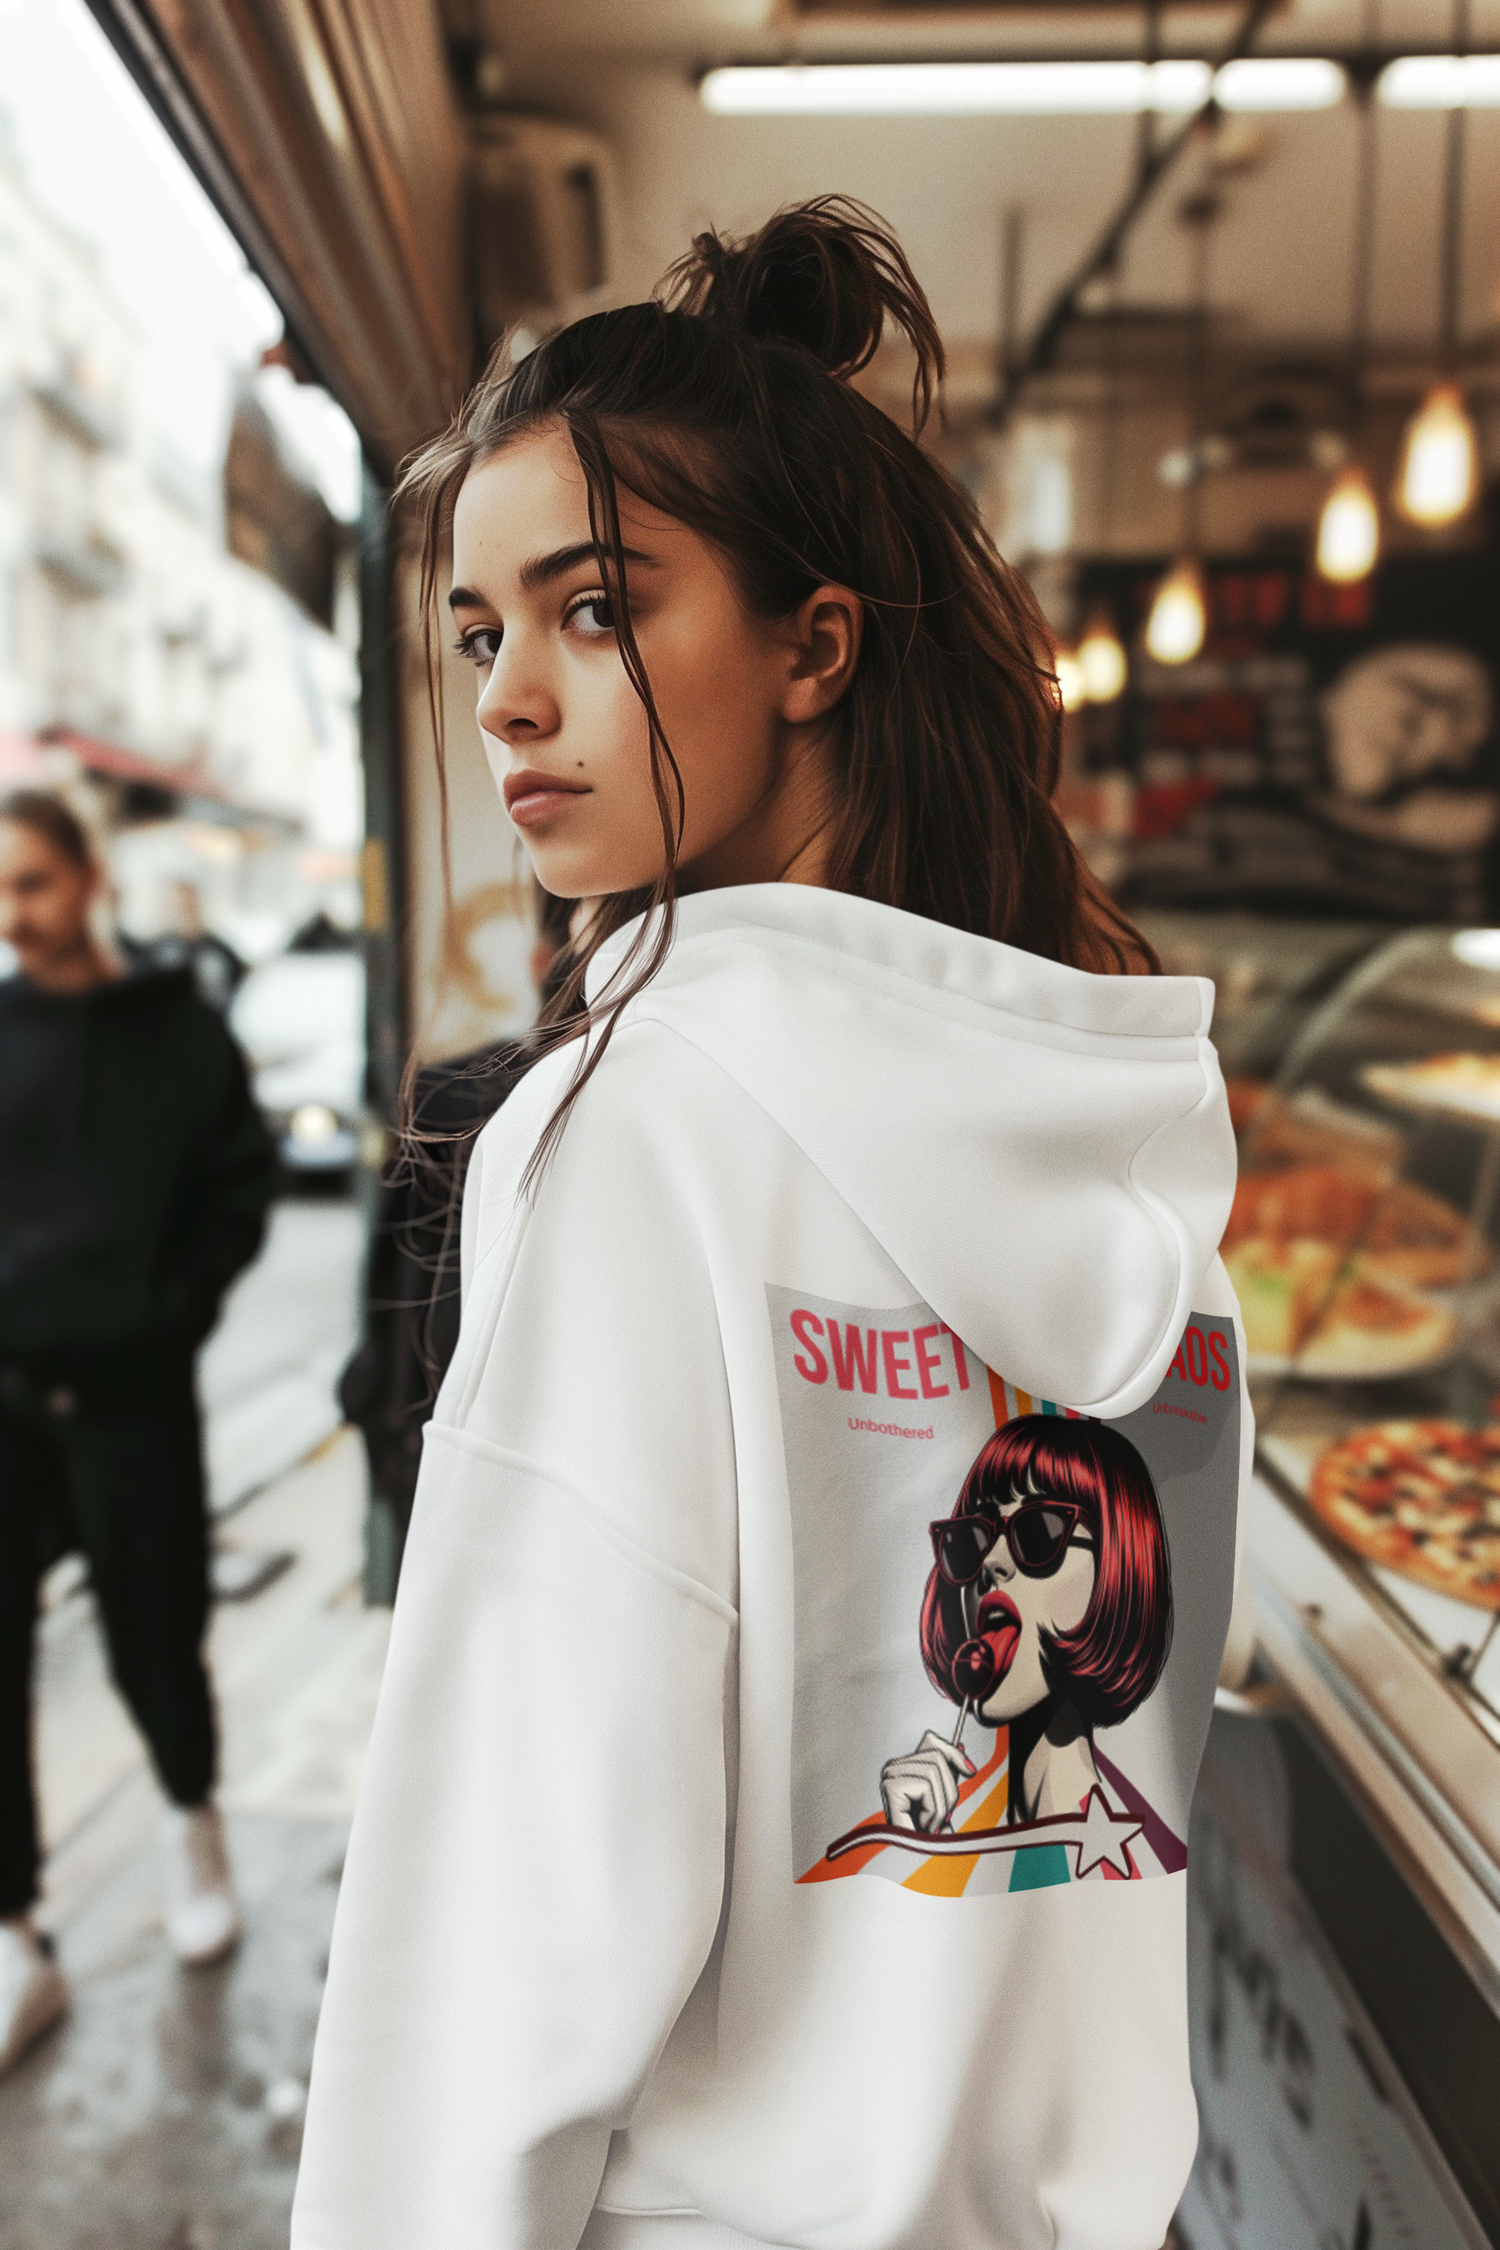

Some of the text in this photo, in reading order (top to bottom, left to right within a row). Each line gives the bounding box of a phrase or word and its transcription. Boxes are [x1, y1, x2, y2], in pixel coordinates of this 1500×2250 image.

[789, 1308, 970, 1400] SWEET
[1152, 1401, 1208, 1426] Unbreakable
[847, 1417, 935, 1440] Unbothered
